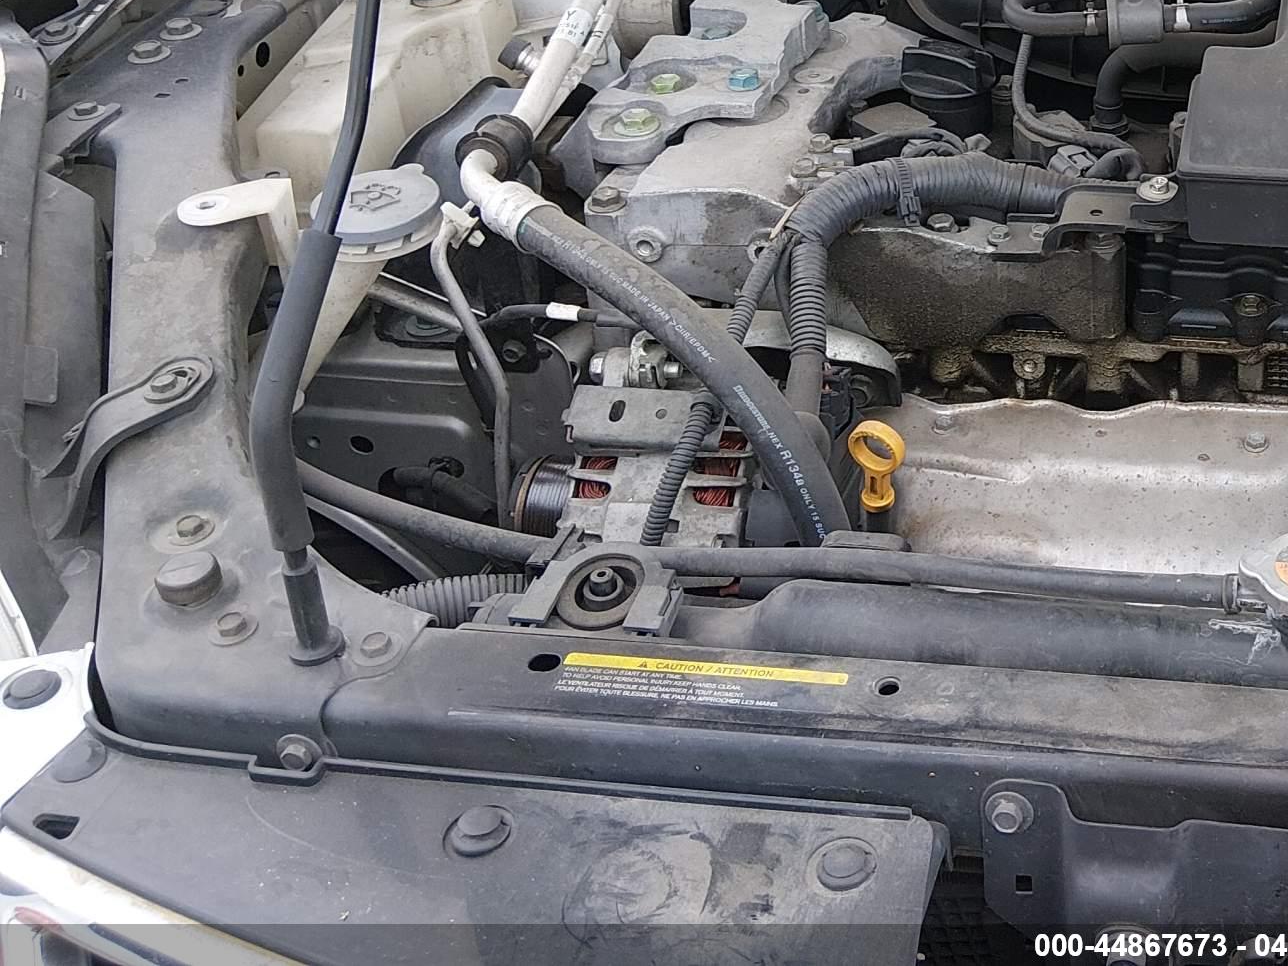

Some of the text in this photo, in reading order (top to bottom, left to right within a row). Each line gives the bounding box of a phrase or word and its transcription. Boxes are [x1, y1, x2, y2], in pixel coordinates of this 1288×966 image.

[621, 281, 641, 297] MADE
[640, 295, 649, 303] IN
[647, 302, 671, 321] JAPAN
[780, 449, 805, 486] R134a
[800, 487, 816, 509] ONLY
[656, 661, 704, 673] CAUTION
[713, 666, 774, 677] ATTENTION
[567, 680, 612, 688] VENTILATEUR
[612, 675, 649, 683] PERSONAL
[697, 696, 740, 705] APPROCHER
